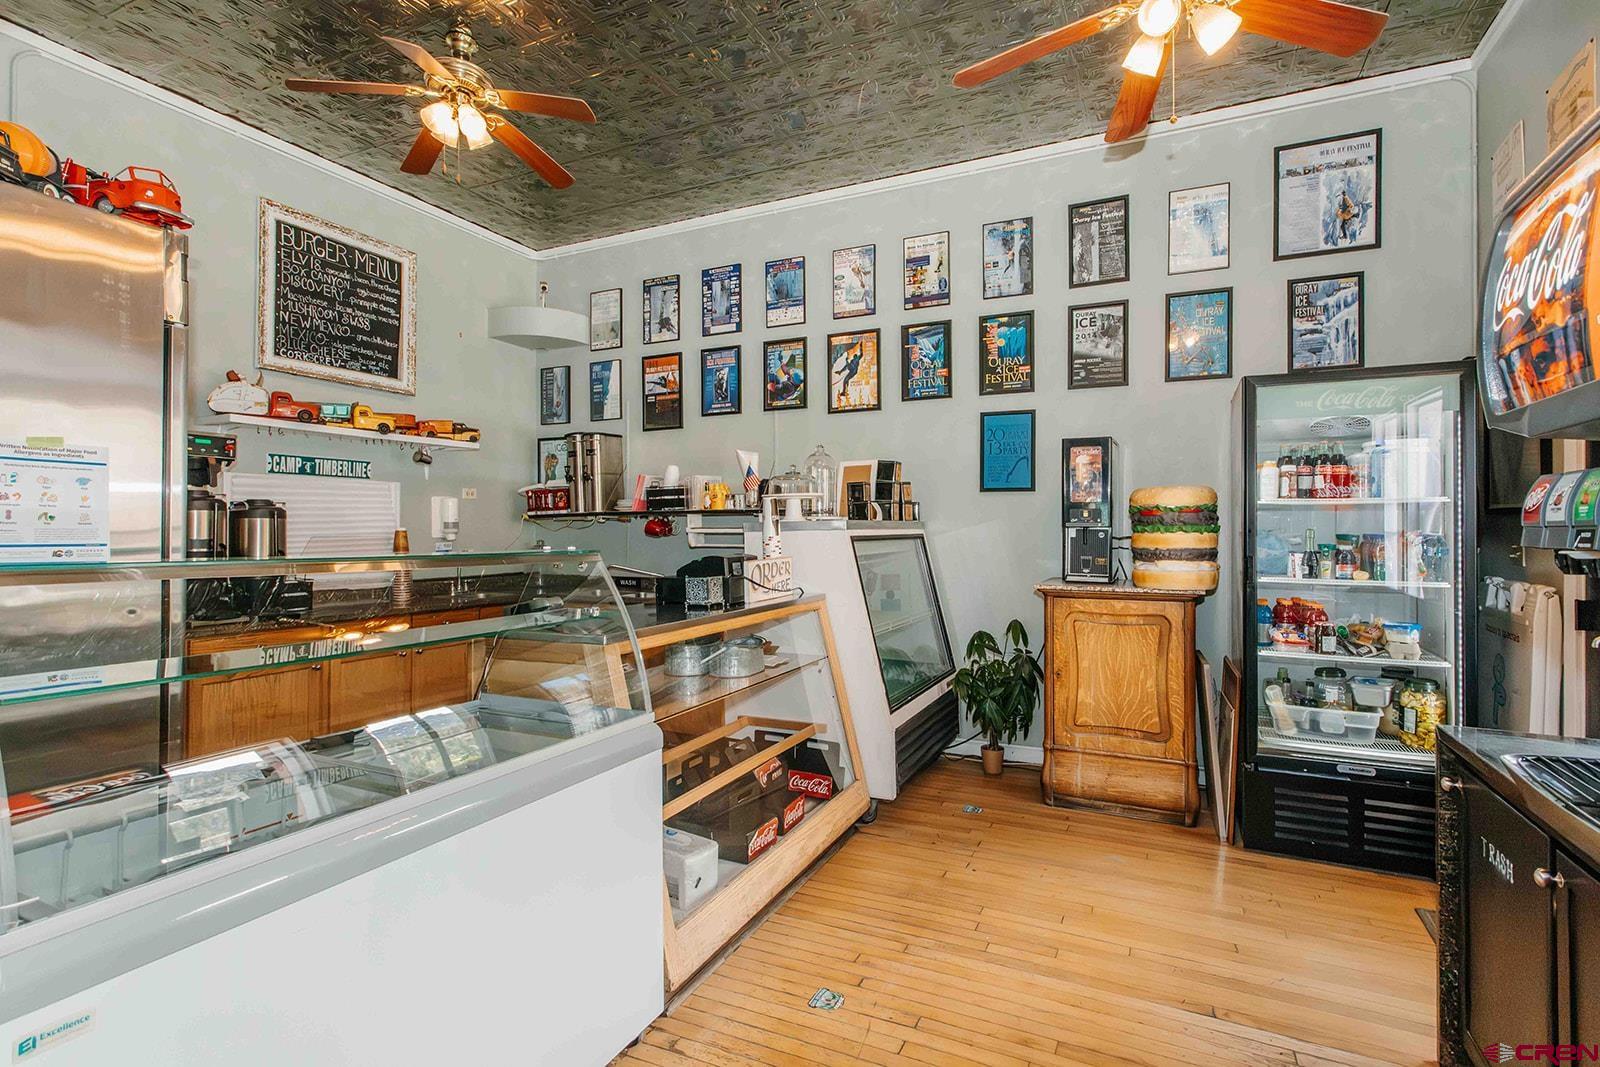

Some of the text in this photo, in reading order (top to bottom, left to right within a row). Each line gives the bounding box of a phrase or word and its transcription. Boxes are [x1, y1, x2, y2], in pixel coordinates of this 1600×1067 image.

[1347, 141, 1372, 153] FESTIVAL
[279, 223, 350, 268] BURGER
[354, 249, 398, 283] MENU
[1493, 187, 1596, 332] Coca-Cola
[281, 259, 310, 277] BOX
[310, 269, 350, 290] CANYON
[280, 298, 339, 322] MUSHROOM
[1195, 305, 1225, 318] OURAY
[1295, 282, 1325, 318] OURAY ICE FESTIVAL
[280, 310, 311, 329] NEW
[312, 318, 351, 337] MEXICO
[1075, 317, 1097, 329] ICE
[1203, 317, 1216, 326] ICE
[277, 334, 308, 353] BLUE
[309, 344, 351, 361] CHEESE
[1075, 332, 1098, 340] 2014
[910, 360, 943, 370] OURAY
[988, 356, 1026, 368] OURAY
[1002, 364, 1020, 376] ICE
[908, 375, 948, 389] FESTIVAL
[985, 371, 1029, 384] FESTIVAL
[1295, 400, 1313, 409] THE
[1317, 385, 1401, 411] Coca-Cola
[1003, 446, 1029, 456] PARTY
[272, 455, 302, 474] CAMP
[314, 458, 367, 478] TIMBERLINE
[751, 560, 791, 591] ORDER
[789, 774, 830, 796] Coca-Cola
[748, 823, 777, 856] Coca-Cola
[1480, 835, 1514, 884] TRASH
[39, 1014, 91, 1041] Excellence
